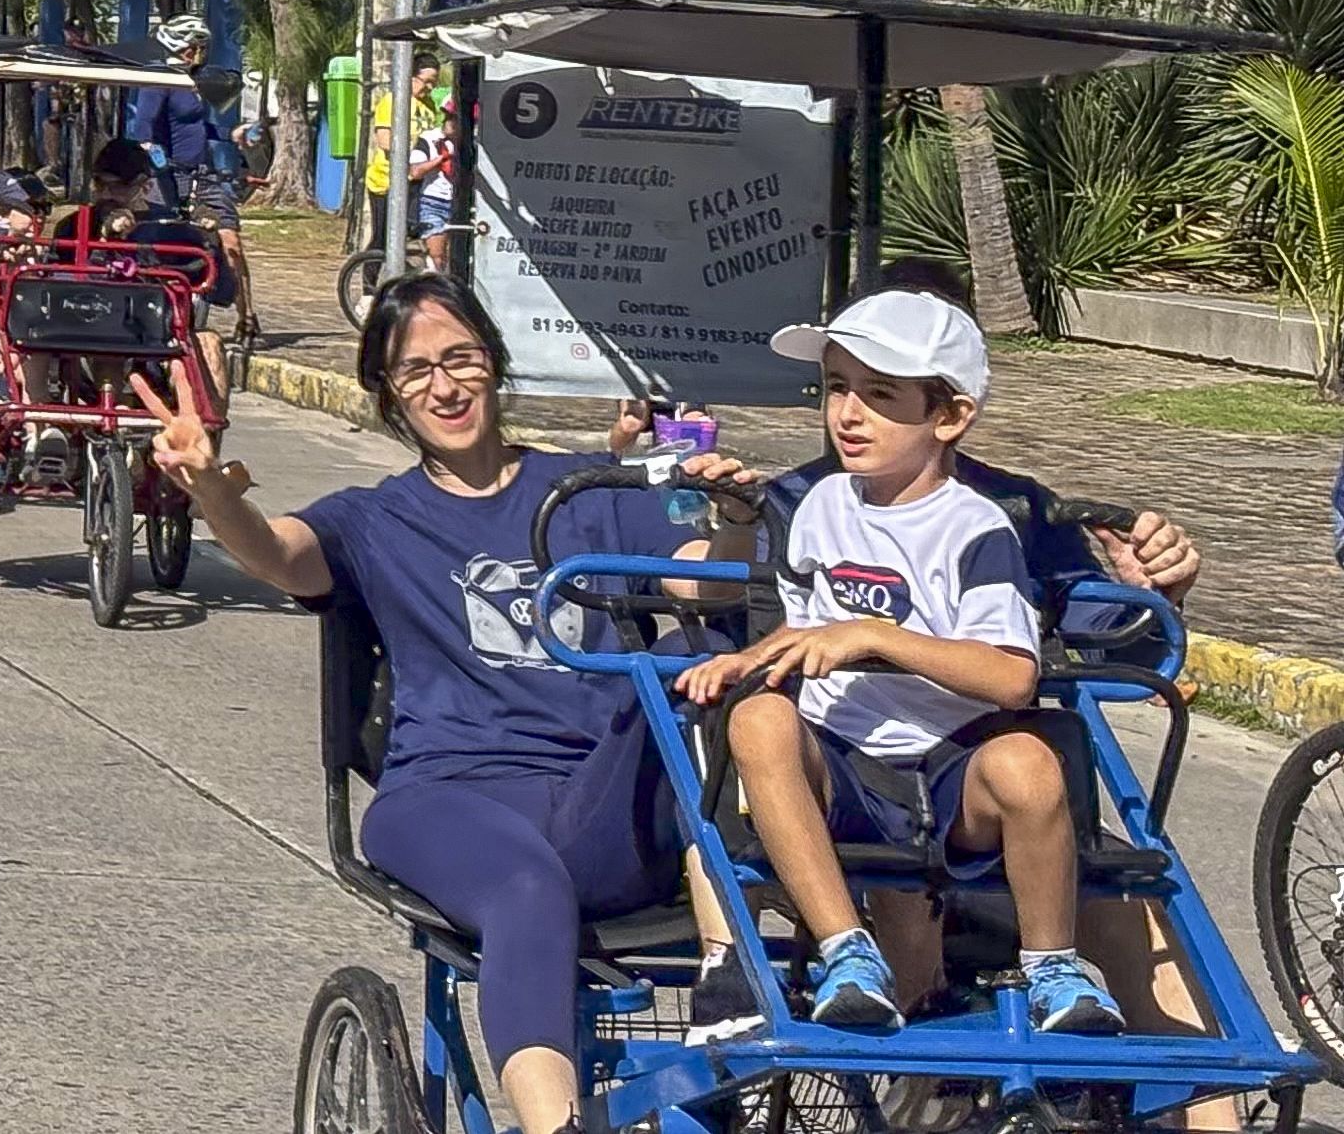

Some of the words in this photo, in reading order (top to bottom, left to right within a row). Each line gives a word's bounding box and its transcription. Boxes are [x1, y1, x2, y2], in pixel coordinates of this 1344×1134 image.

[515, 93, 540, 123] 5
[587, 98, 740, 130] RENTBIKE
[514, 161, 570, 181] PONTOS
[575, 165, 598, 183] DE
[600, 164, 676, 191] LOCAÇÃO:
[549, 196, 616, 216] JAQUEIRA
[688, 187, 739, 223] FAÇA
[743, 173, 780, 205] SEU
[532, 217, 579, 236] RECIFE
[581, 220, 632, 239] ANTIGO
[706, 207, 782, 252] EVENTO
[496, 236, 524, 254] BOA
[528, 238, 578, 258] VIAGEM
[614, 245, 668, 263] JARDIM
[702, 232, 807, 287] CONOSCO!!
[518, 259, 577, 280] RESERVA
[579, 264, 599, 281] DO
[602, 266, 643, 284] PAIVA
[618, 299, 690, 317] Contato:
[532, 317, 551, 332] 81
[661, 325, 680, 339] 81
